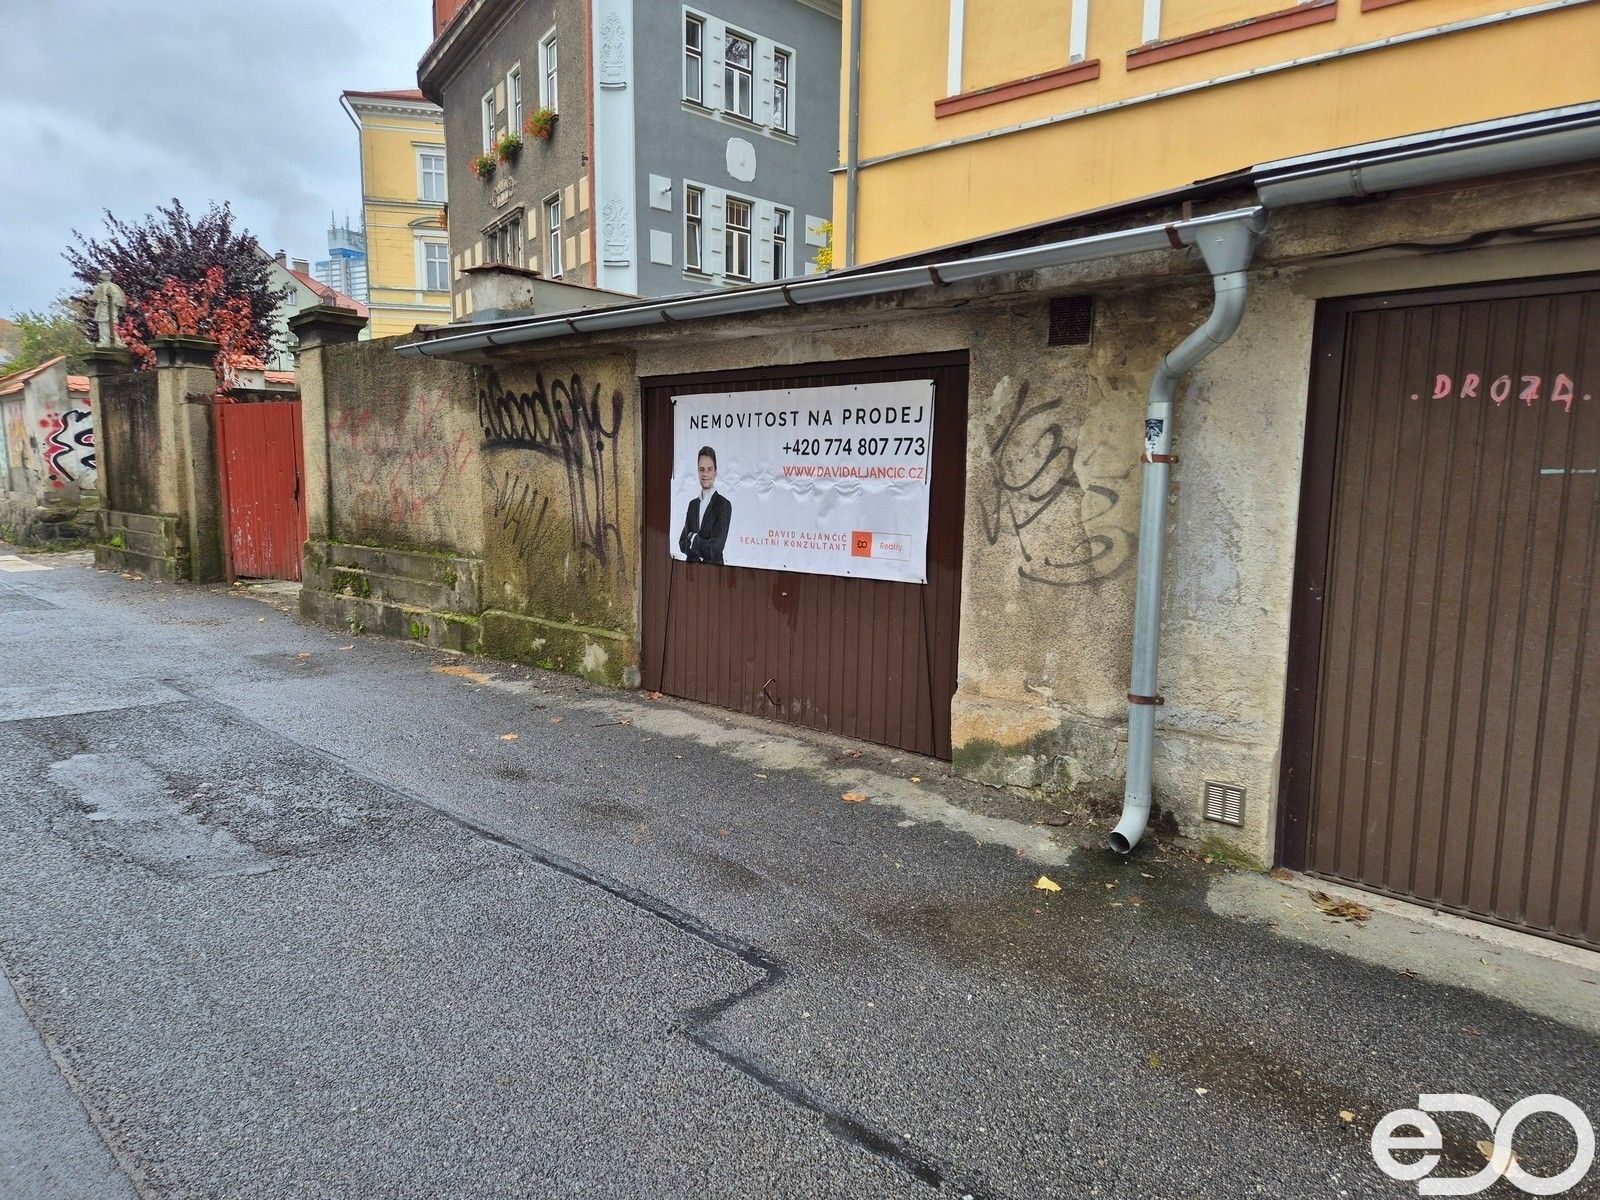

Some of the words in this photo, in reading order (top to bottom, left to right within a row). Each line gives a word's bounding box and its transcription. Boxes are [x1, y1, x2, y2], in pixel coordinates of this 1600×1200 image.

[690, 411, 799, 430] NEMOVITOST
[808, 410, 833, 426] NA
[842, 406, 924, 424] PRODEJ
[783, 439, 820, 455] +420
[824, 438, 852, 455] 774
[858, 438, 889, 455] 807
[894, 437, 925, 455] 773
[783, 465, 924, 479] WWW.DAVIDALJANCIC.CZ
[768, 529, 796, 538] DAVID
[784, 540, 847, 551] KONZULTANT
